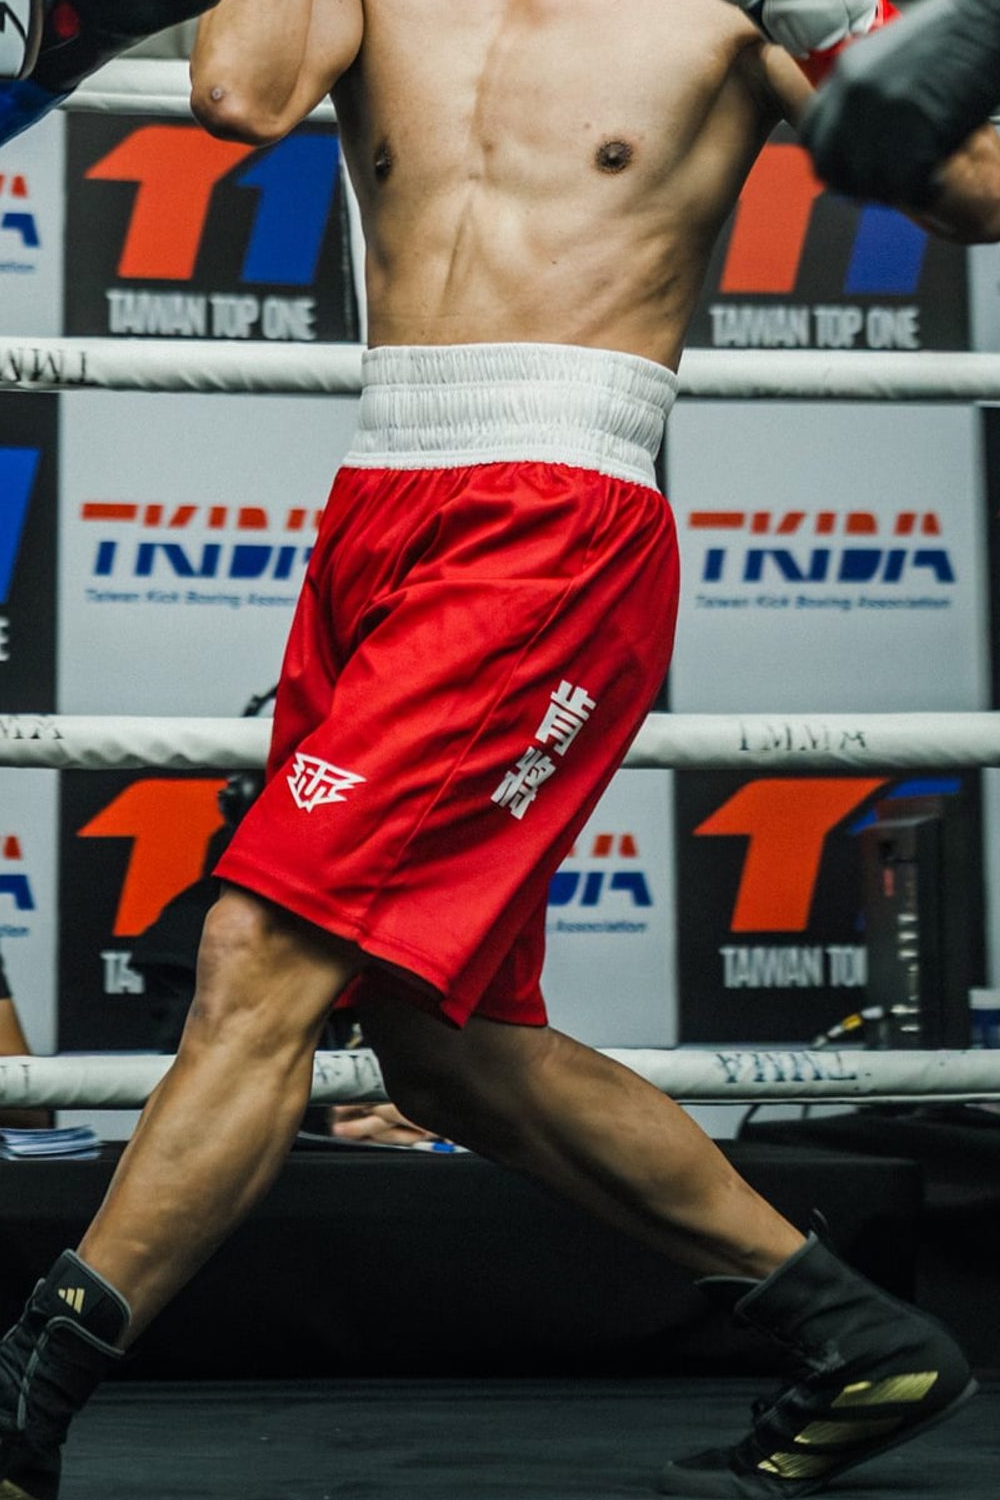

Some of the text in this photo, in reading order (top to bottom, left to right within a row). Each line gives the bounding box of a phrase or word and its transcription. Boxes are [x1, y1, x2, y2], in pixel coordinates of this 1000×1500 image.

[105, 288, 317, 341] TAIWAN TOP ONE
[709, 303, 921, 349] TAIWAN TOP ONE
[719, 945, 823, 988] TAIWAN
